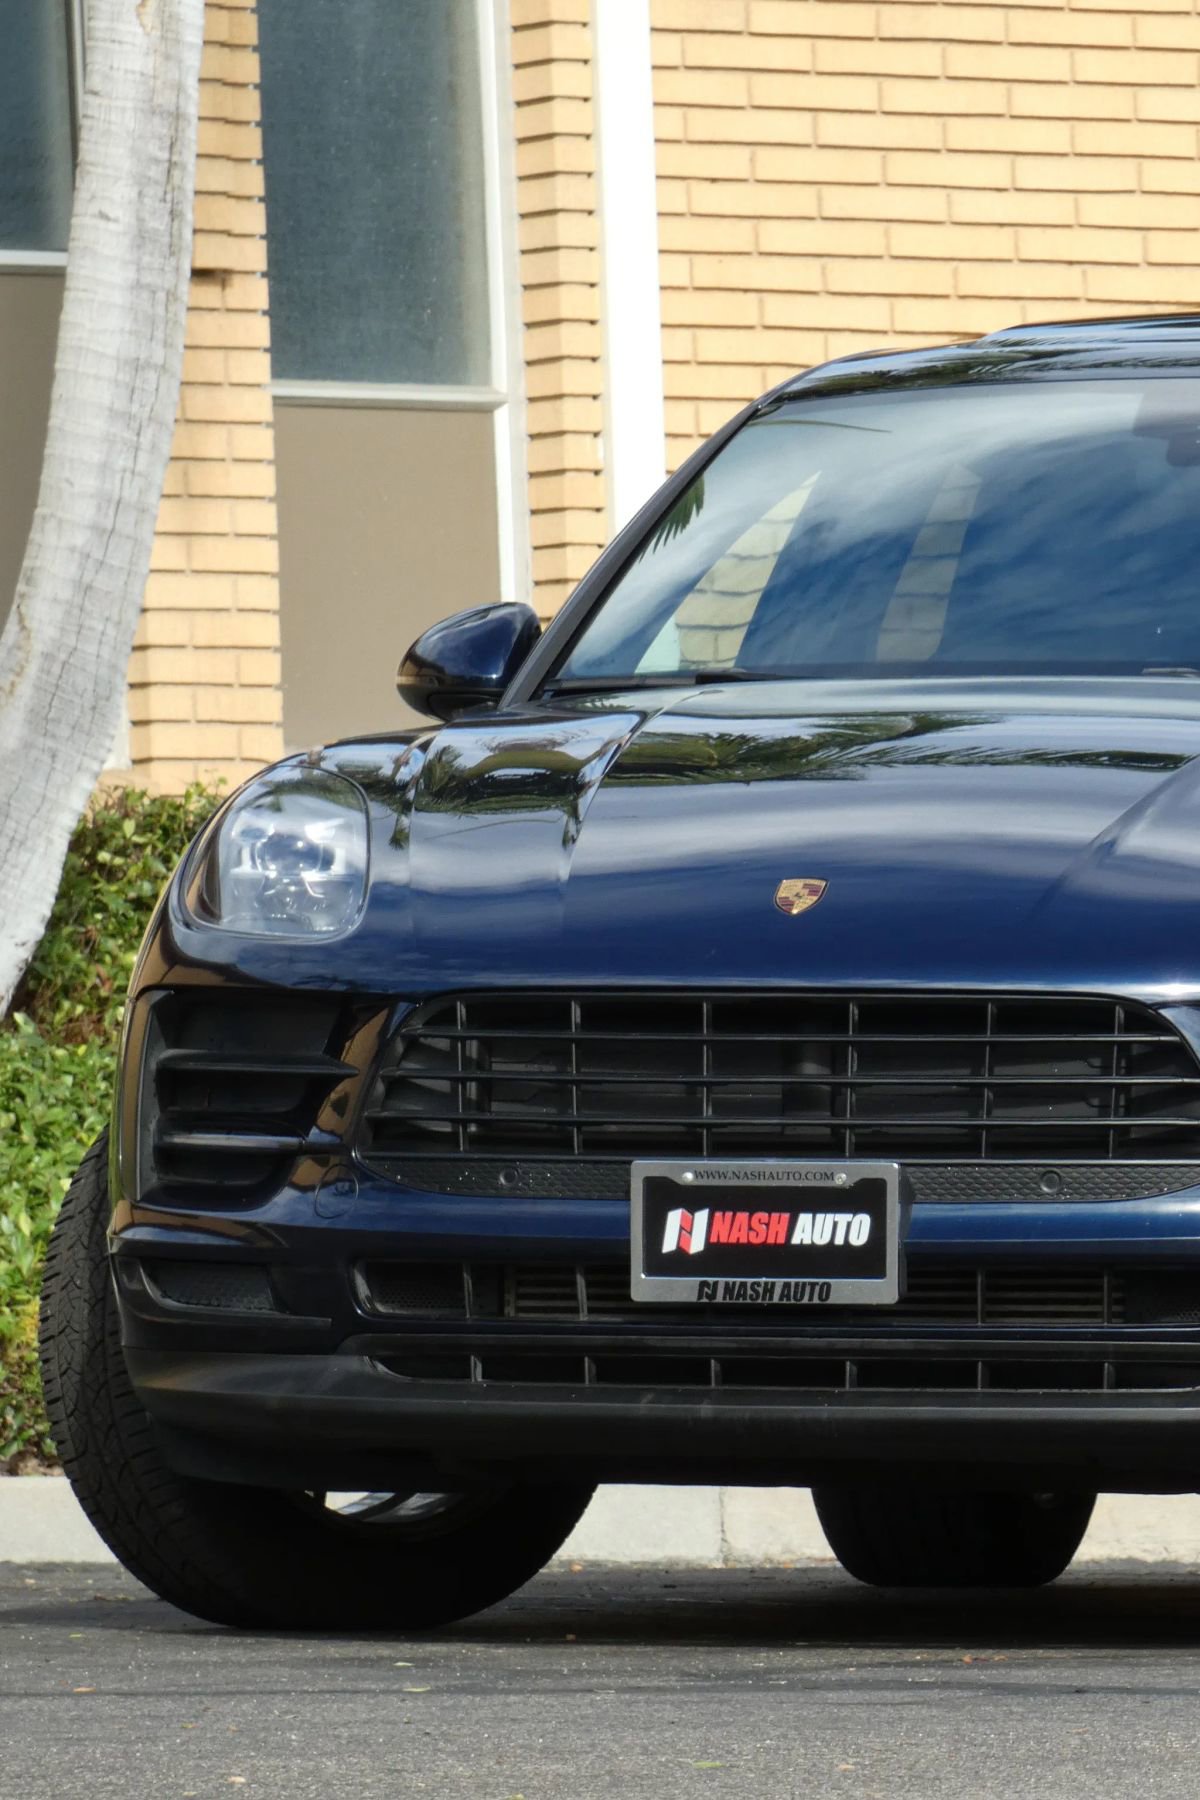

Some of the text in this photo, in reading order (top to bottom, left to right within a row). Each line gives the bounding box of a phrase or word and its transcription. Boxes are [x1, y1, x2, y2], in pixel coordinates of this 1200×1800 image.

[693, 1168, 835, 1182] WWW.NASHAUTO.COM
[709, 1210, 791, 1245] NASH
[790, 1212, 872, 1247] AUTO
[721, 1281, 777, 1303] NASH
[778, 1281, 833, 1303] AUTO
